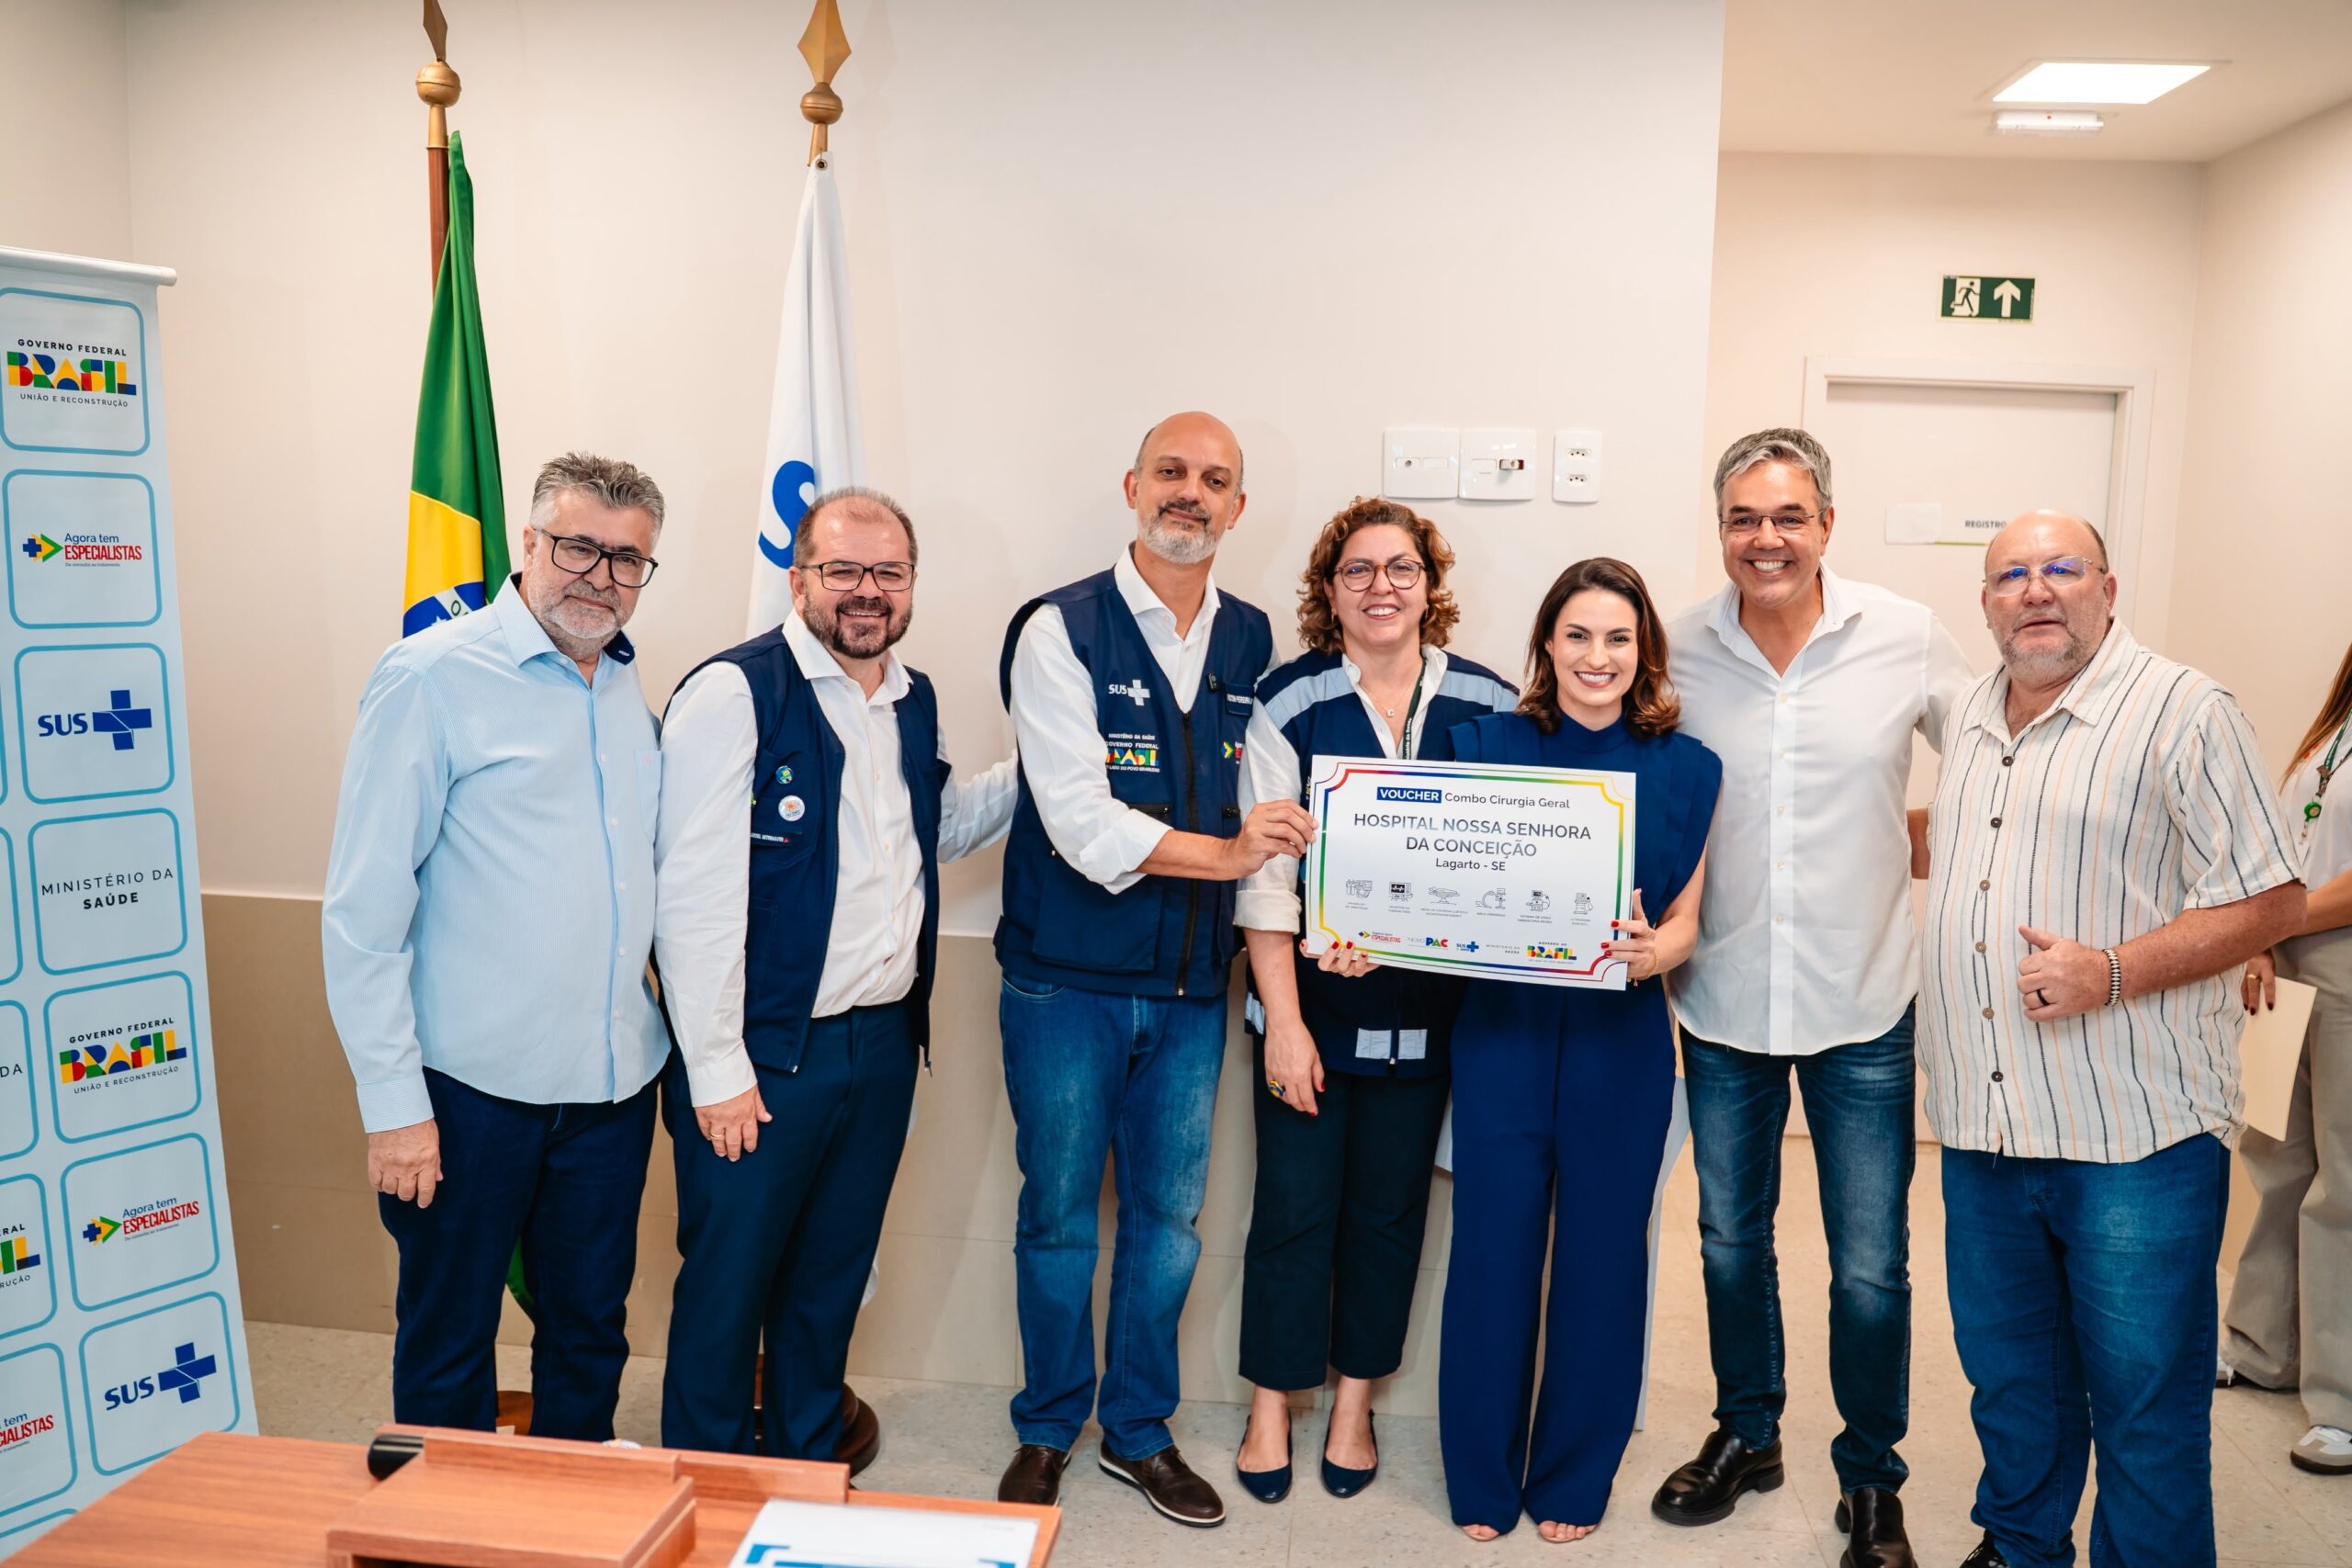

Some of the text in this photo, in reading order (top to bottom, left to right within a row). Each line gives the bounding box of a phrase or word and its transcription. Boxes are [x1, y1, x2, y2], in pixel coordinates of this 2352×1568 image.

[17, 338, 127, 356] GOVERNO FEDERAL
[6, 351, 137, 396] BRASIL
[20, 392, 49, 402] UNIÃO
[61, 397, 129, 409] RECONSTRUÇÃO
[64, 533, 119, 545] Agora tem
[64, 545, 142, 560] ESPECIALISTAS
[1108, 684, 1127, 694] SUS
[37, 712, 88, 737] SUS
[1379, 788, 1570, 808] VOUCHER Combo Cirurgia Geral
[1354, 813, 1591, 840] HOSPITAL NOSSA SENHORA
[1407, 837, 1537, 859] DA CONCEIÇÃO
[1435, 858, 1480, 871] Lagarto
[1491, 861, 1506, 872] SE
[41, 867, 174, 896] MINISTÉRIO DA
[83, 891, 139, 909] SAÚDE
[1426, 937, 1448, 948] PAC
[1526, 945, 1577, 960] BRASIL
[69, 1017, 175, 1043] GOVERNO FEDERAL
[59, 1029, 187, 1084] BRASIL
[74, 1082, 101, 1094] UNIÃO
[113, 1066, 179, 1086] RECONSTRUÇÃO
[122, 1197, 177, 1218] Agora tem
[123, 1201, 199, 1235] ESPECIALISTAS
[0, 1224, 26, 1236] RAL
[104, 1376, 154, 1411] SUS
[4, 1413, 28, 1427] tem
